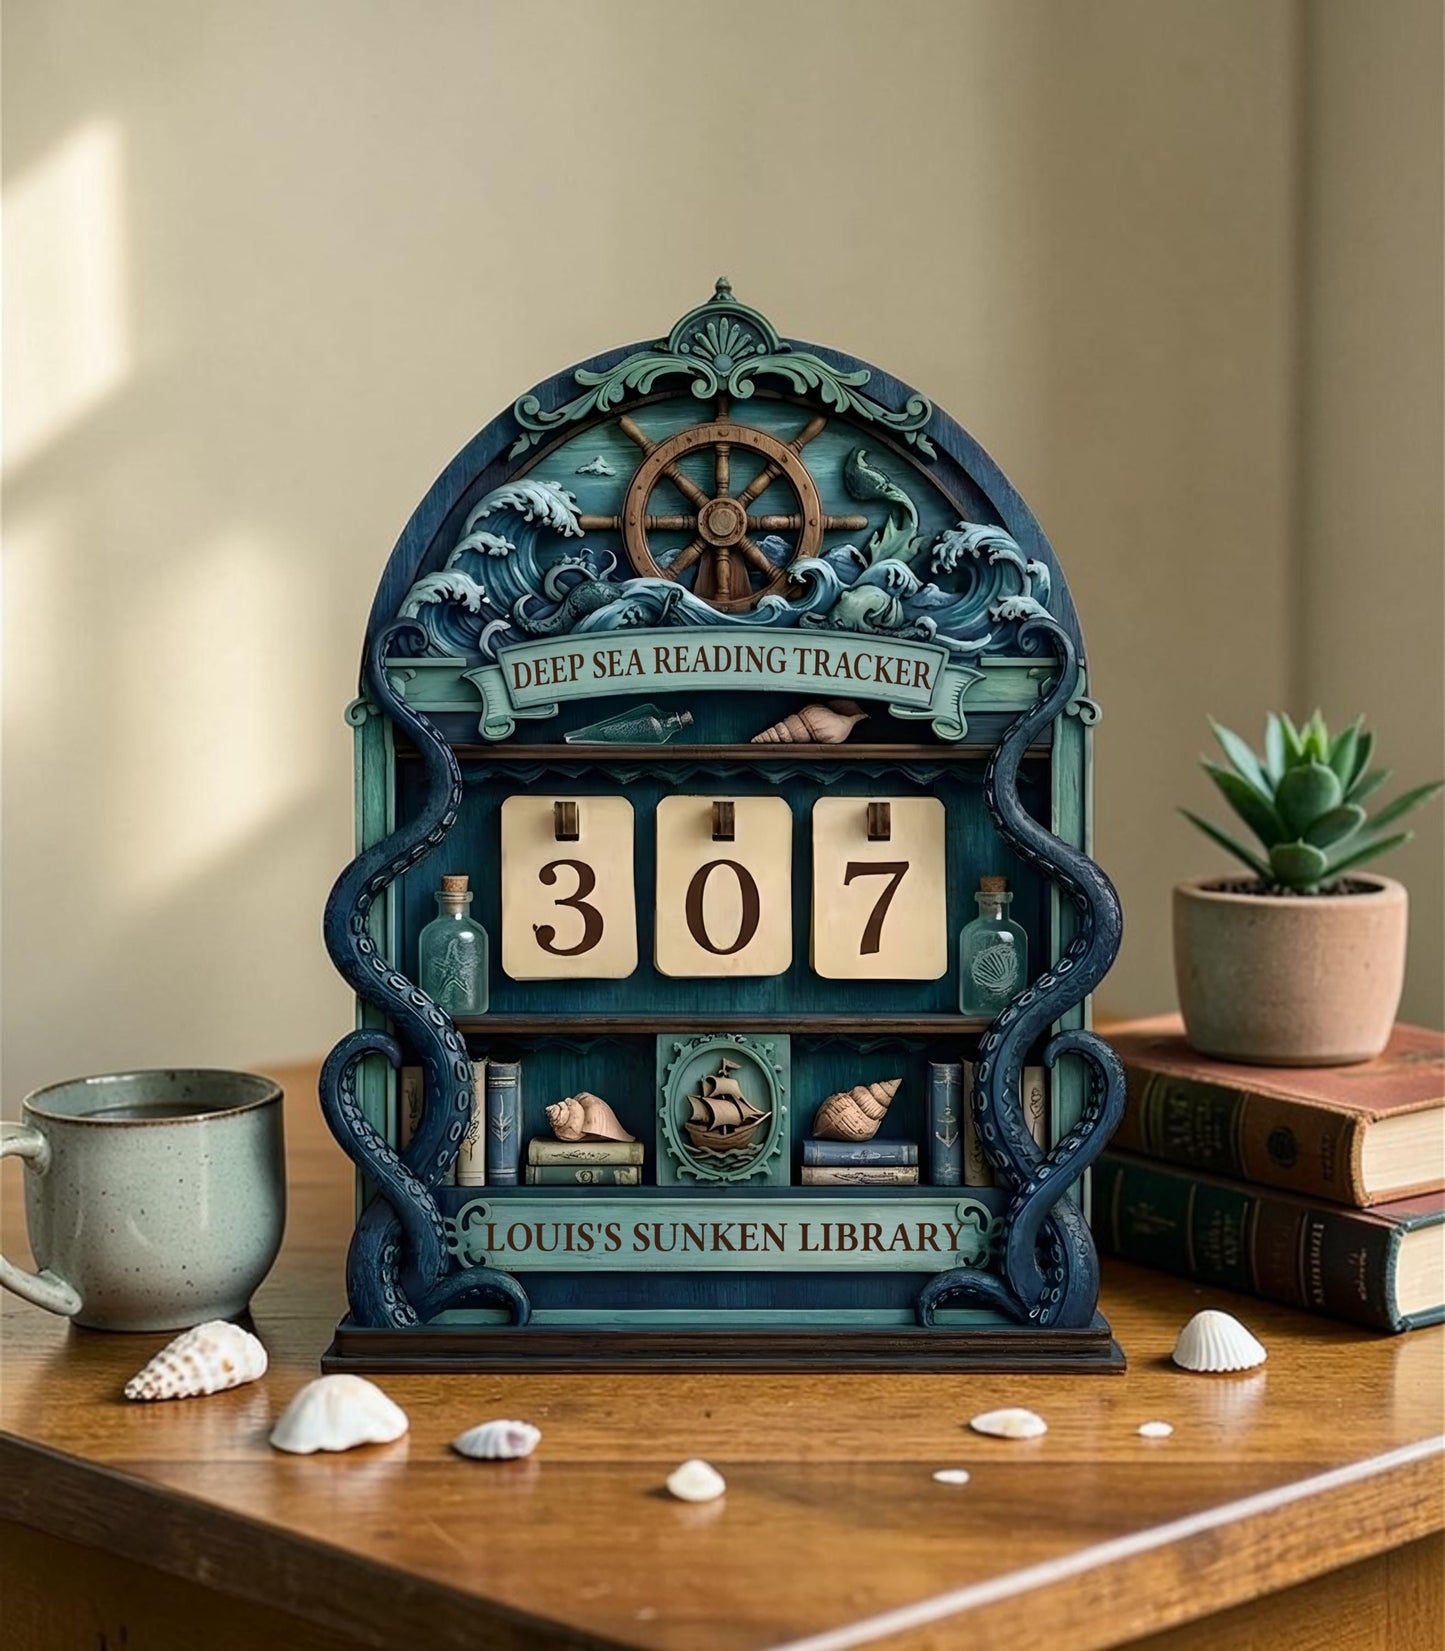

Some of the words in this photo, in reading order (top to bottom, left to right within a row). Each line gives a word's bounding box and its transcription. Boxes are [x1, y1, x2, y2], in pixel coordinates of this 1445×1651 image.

[512, 653, 585, 690] DEEP
[592, 648, 646, 679] SEA
[652, 645, 787, 675] READING
[793, 646, 932, 691] TRACKER
[484, 1221, 623, 1253] LOUIS'S
[632, 1221, 788, 1253] SUNKEN
[798, 1221, 966, 1253] LIBRARY
